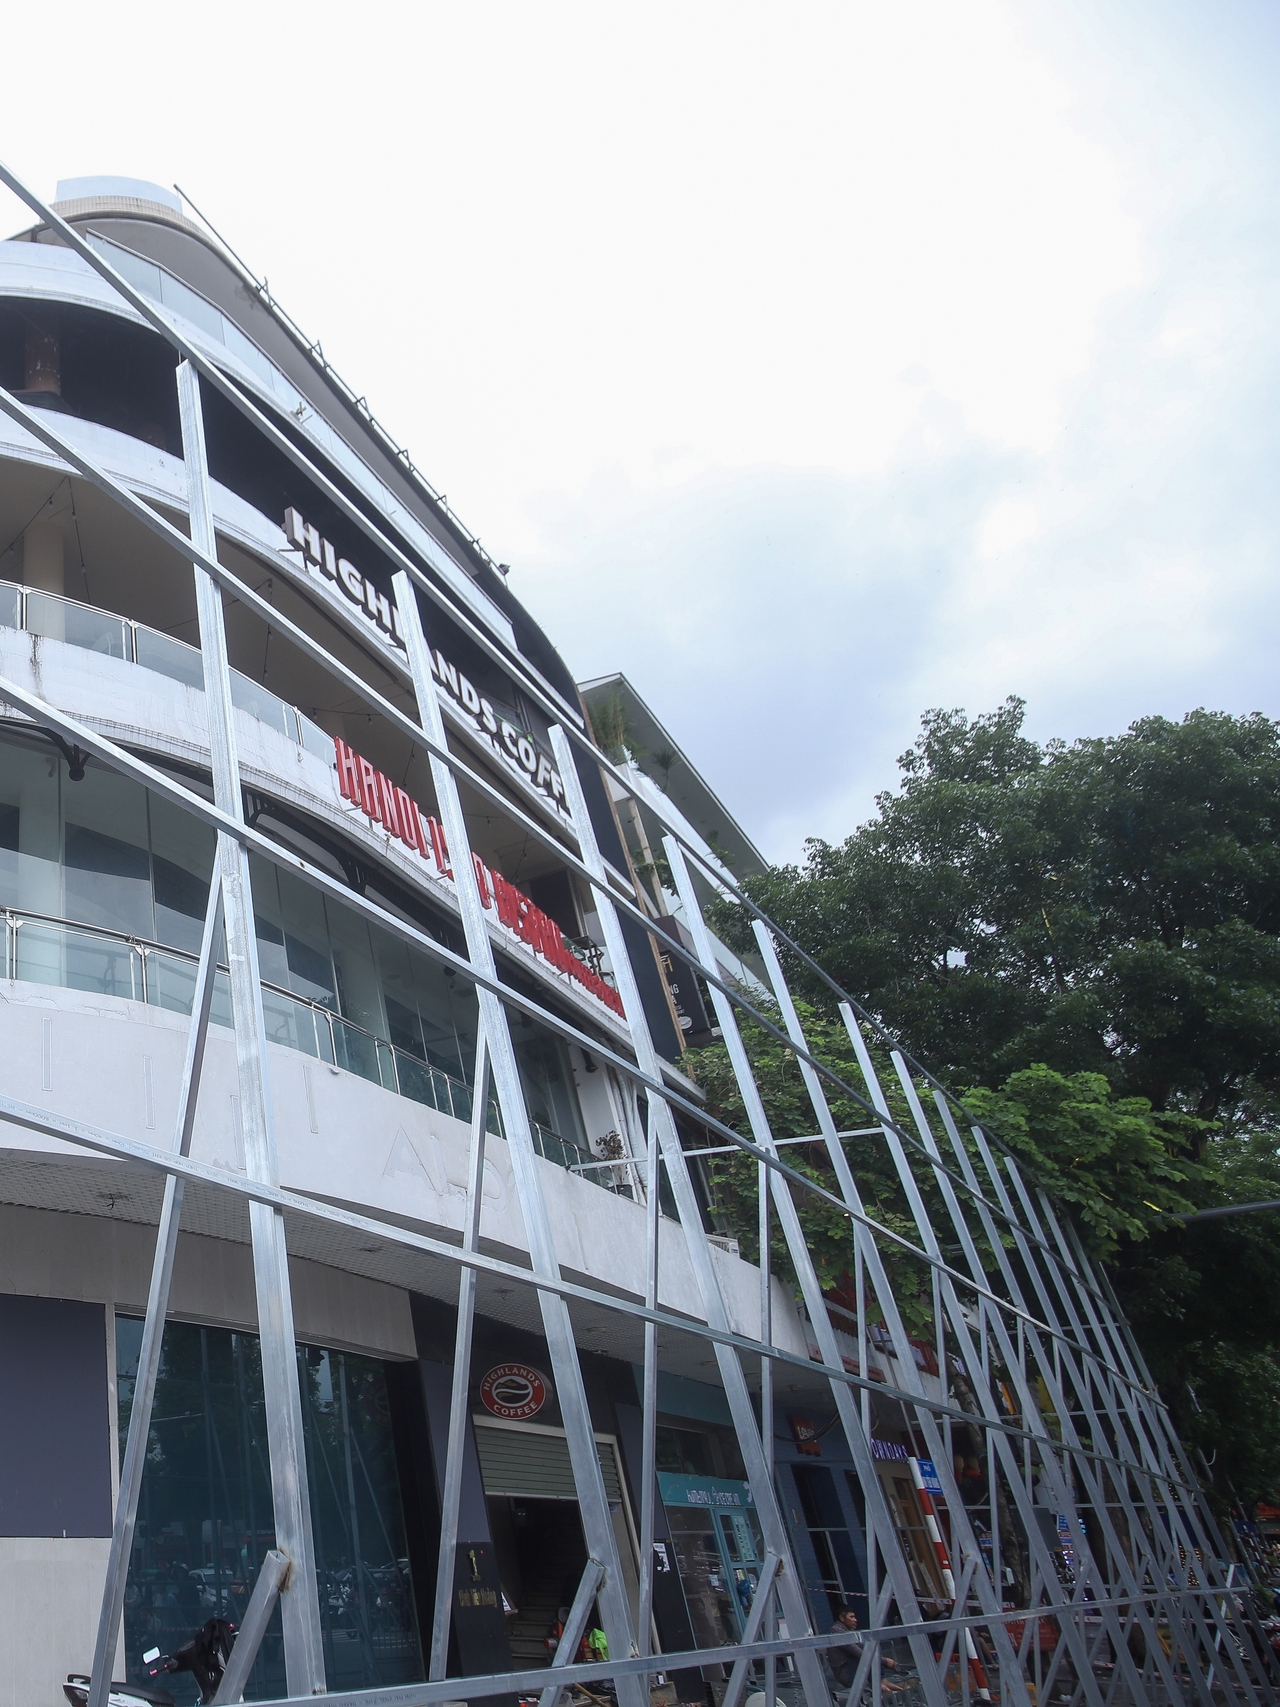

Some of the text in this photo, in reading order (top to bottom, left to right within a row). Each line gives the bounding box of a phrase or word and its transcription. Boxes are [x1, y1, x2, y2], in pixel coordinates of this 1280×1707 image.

[284, 506, 498, 734] HIGHLNDS
[333, 735, 430, 860] HANOI
[483, 1367, 540, 1391] HIGHLANDS
[493, 1401, 538, 1416] COFFEE
[871, 1437, 908, 1460] OWNDAYS
